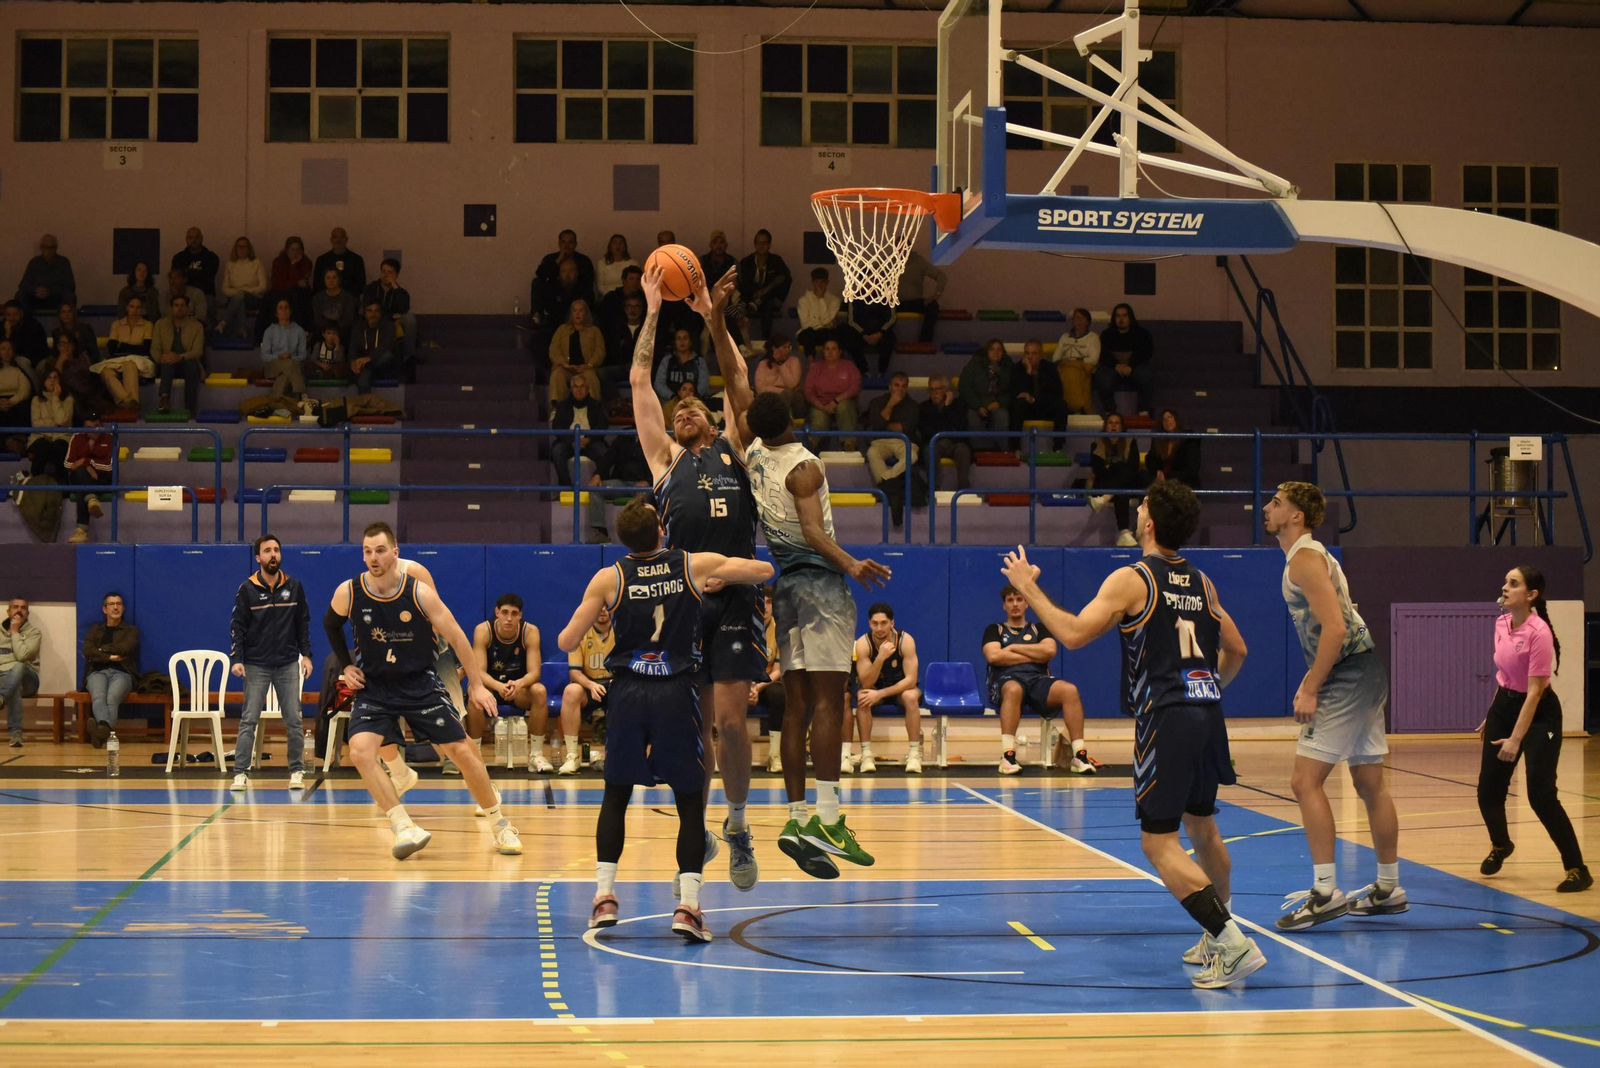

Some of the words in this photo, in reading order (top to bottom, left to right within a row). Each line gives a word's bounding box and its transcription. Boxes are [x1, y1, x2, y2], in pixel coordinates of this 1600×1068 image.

[119, 155, 126, 165] 3
[828, 161, 835, 170] 4
[1038, 209, 1112, 226] SPORT
[1113, 211, 1204, 233] SYSTEM
[710, 498, 728, 517] 15
[637, 563, 671, 577] SEARA
[650, 579, 683, 597] STROG
[650, 604, 665, 642] 1
[386, 648, 397, 663] 4
